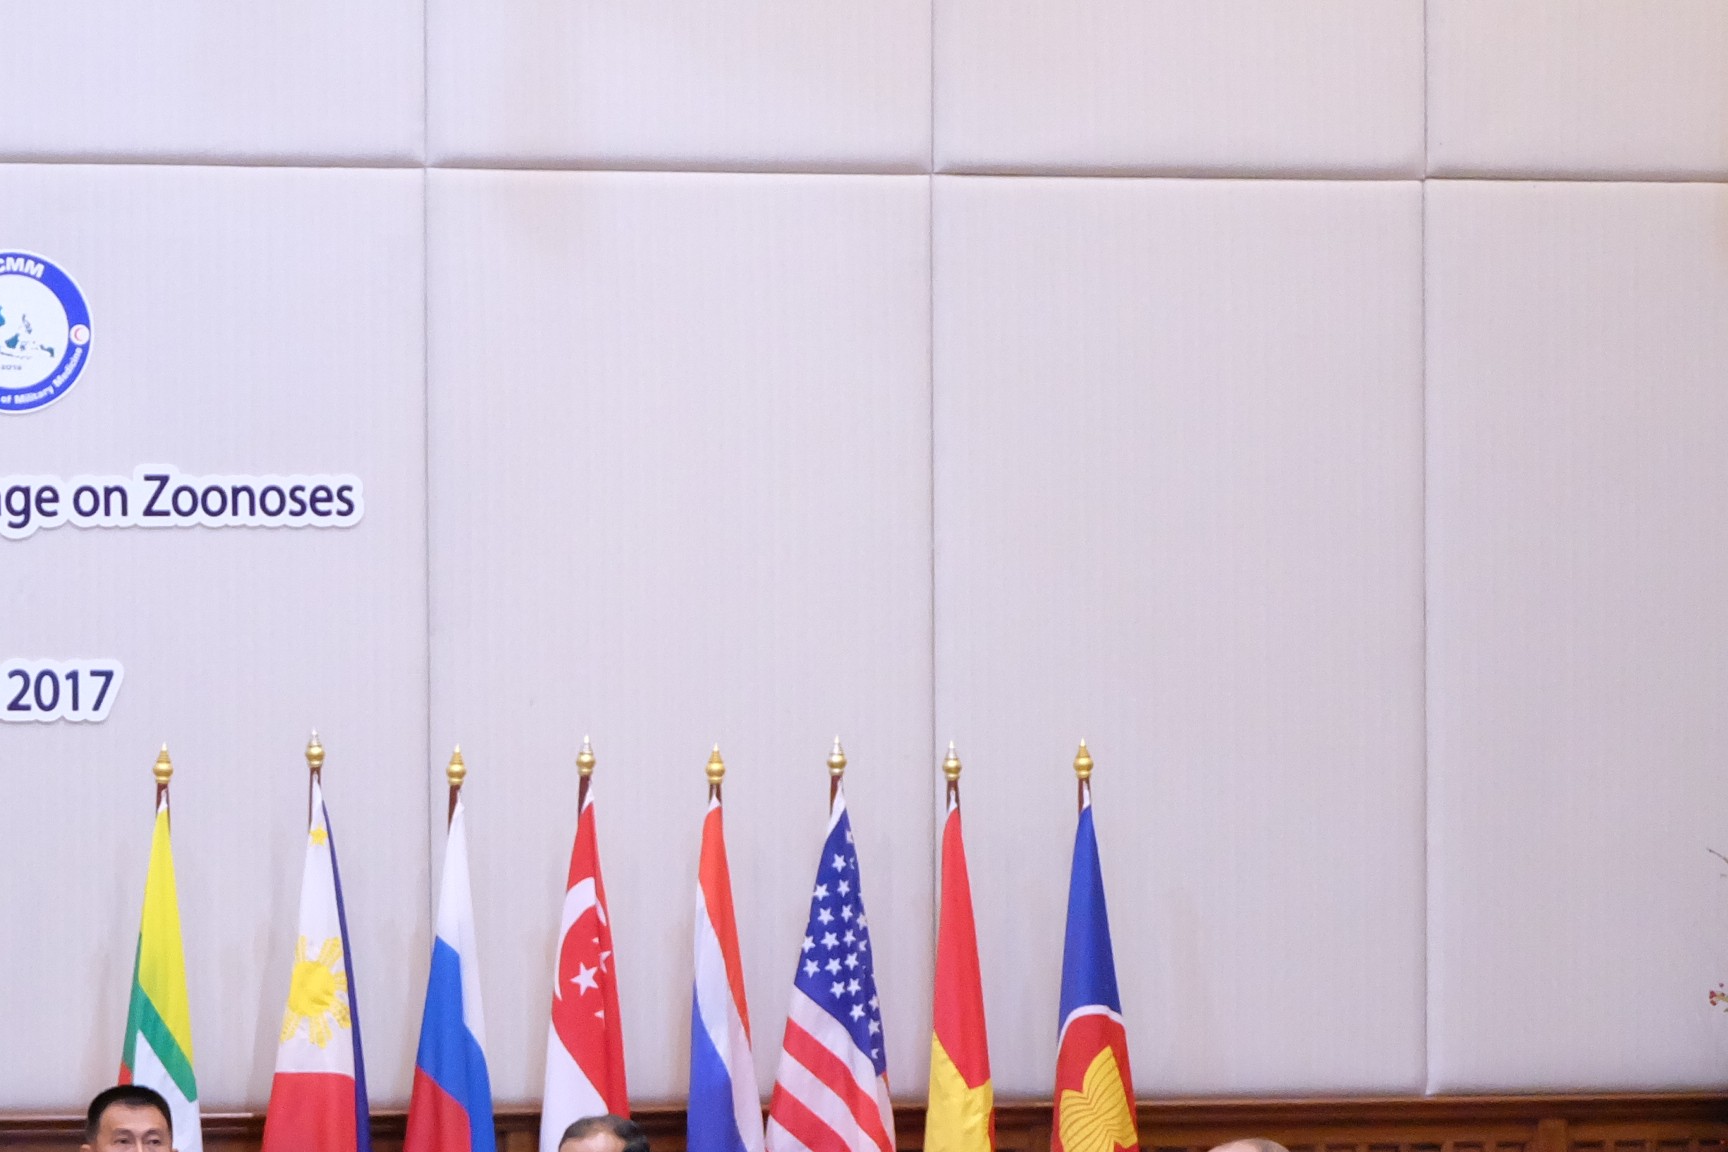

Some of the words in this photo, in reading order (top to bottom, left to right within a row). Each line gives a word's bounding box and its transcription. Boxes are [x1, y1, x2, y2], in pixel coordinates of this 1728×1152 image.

[0, 394, 12, 404] of
[14, 383, 55, 405] Military
[53, 347, 84, 389] Medicine
[73, 486, 128, 517] on
[142, 475, 354, 517] Zoonoses
[7, 669, 114, 712] 2017
